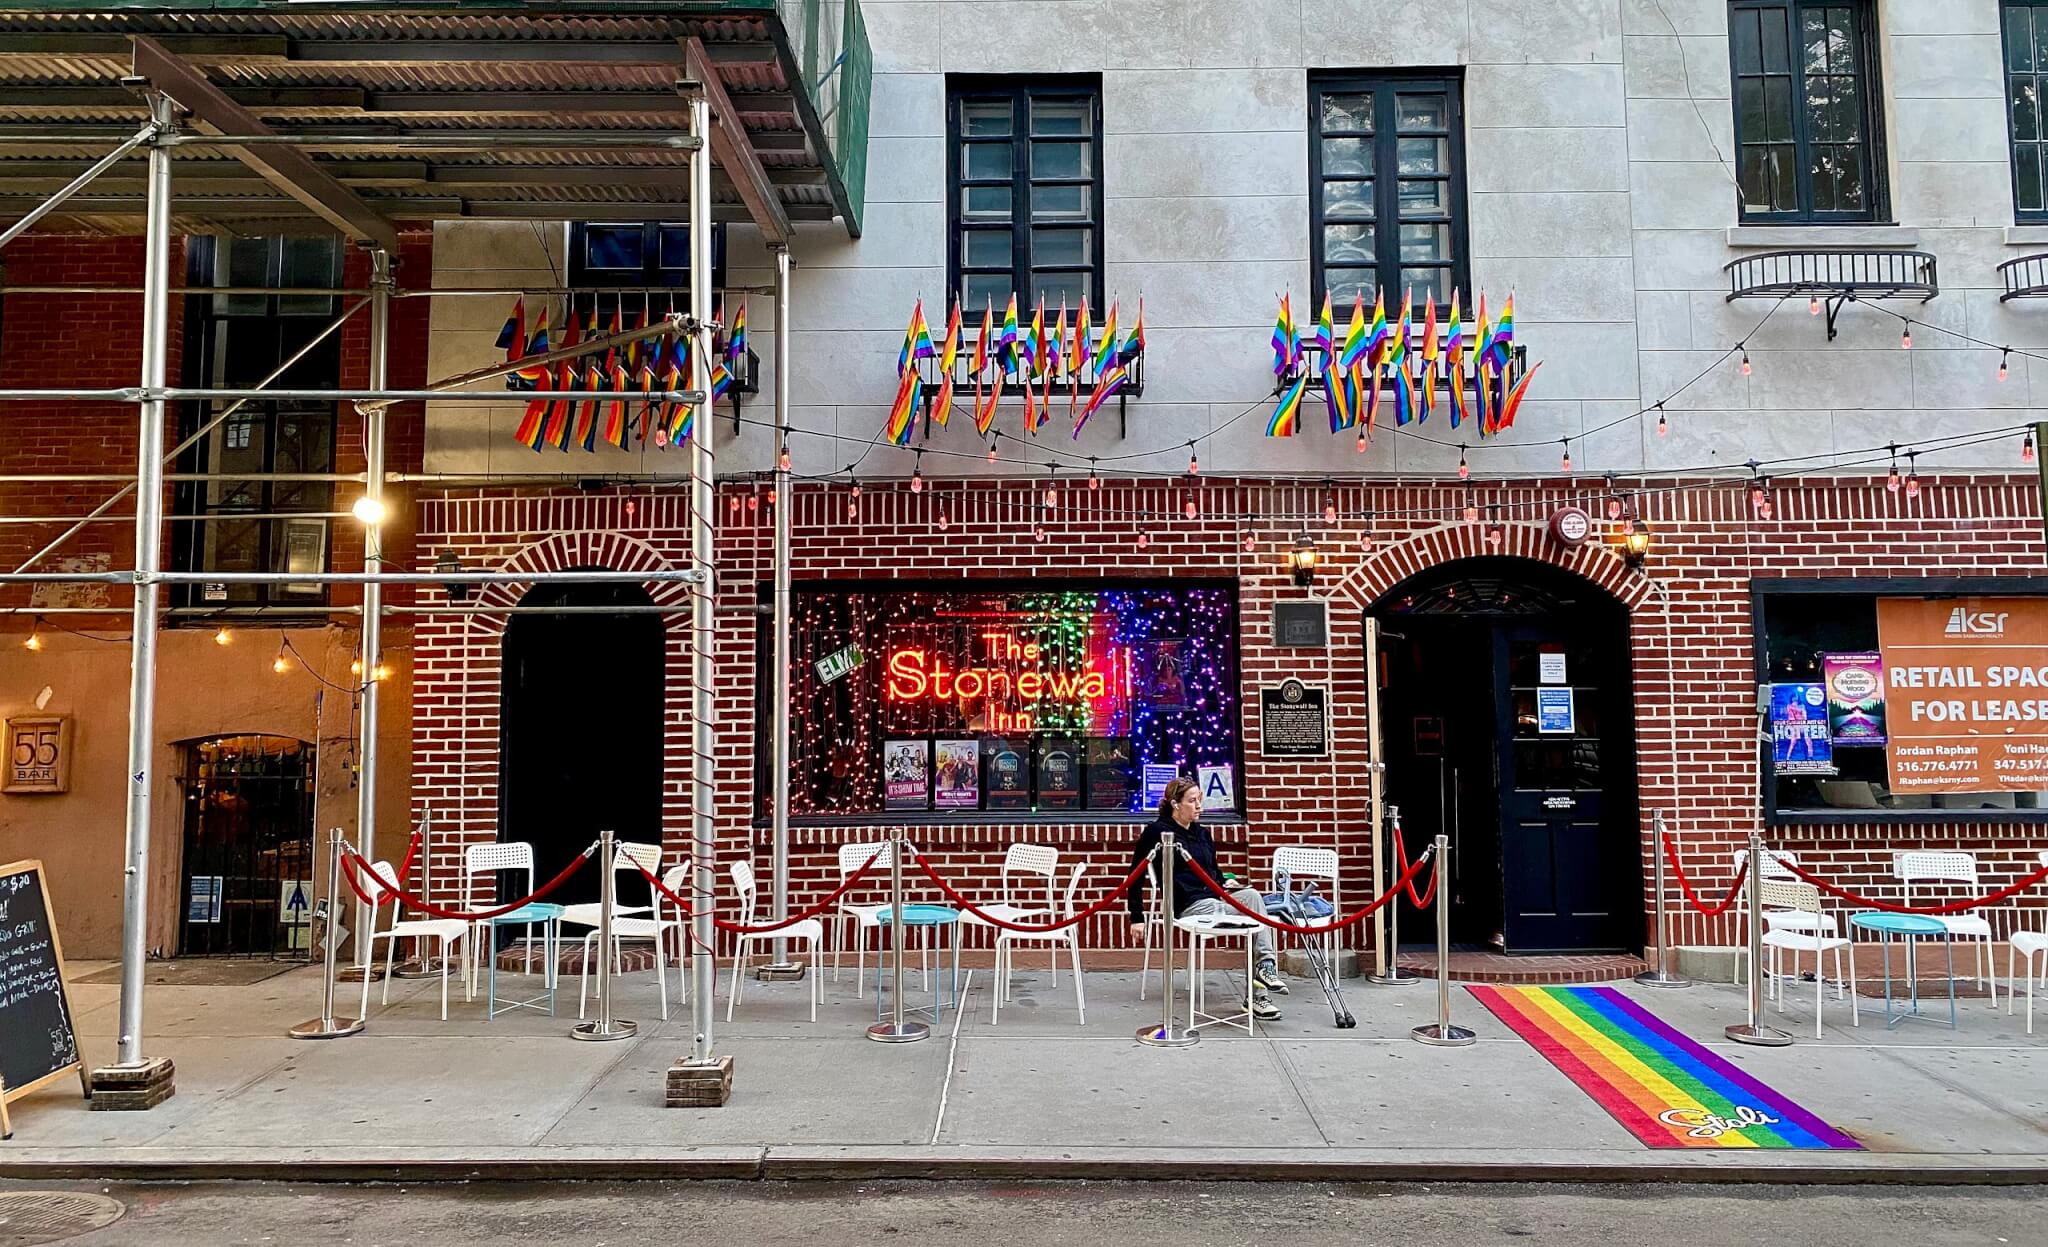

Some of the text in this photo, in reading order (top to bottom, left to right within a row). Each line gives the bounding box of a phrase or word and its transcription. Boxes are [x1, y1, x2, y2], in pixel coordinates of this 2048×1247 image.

[1960, 607, 2008, 632] ksr
[982, 633, 1039, 661] The
[888, 647, 1133, 701] Stonewall
[1890, 666, 1982, 688] RETAIL
[989, 702, 1031, 730] Inn
[1911, 699, 2048, 721] FOR LEASE
[1774, 724, 1828, 740] HOTTER
[15, 731, 58, 767] 55
[1896, 745, 1978, 756] Jordan Raphan
[2004, 744, 2028, 754] Yoni
[18, 770, 50, 779] BAR
[1897, 760, 1978, 772] 516.776.4771
[1994, 760, 2048, 770] 347.517.
[1206, 772, 1227, 797] A
[10, 874, 30, 895] $20
[286, 884, 308, 911] A
[1659, 1105, 1780, 1138] Stoli
